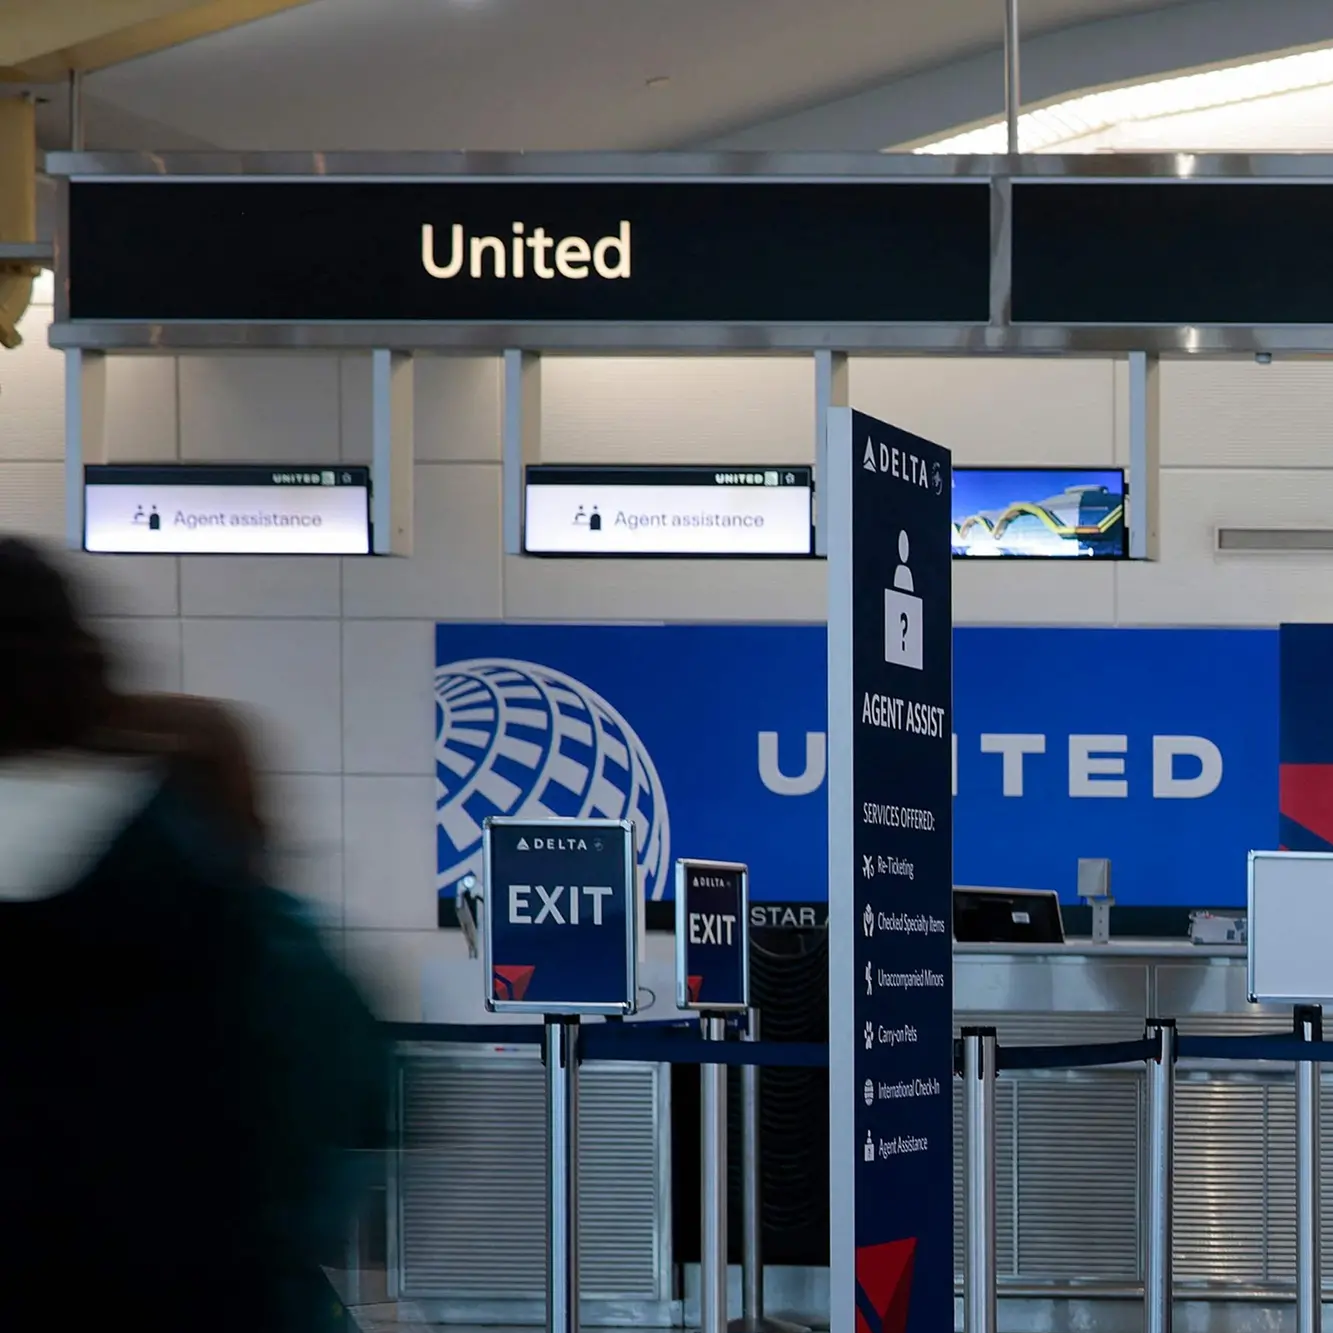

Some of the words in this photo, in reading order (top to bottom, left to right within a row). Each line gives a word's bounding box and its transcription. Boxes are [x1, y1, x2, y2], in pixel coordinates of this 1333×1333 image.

[421, 219, 631, 279] United
[879, 442, 929, 489] DELTA
[272, 474, 320, 484] UNITED
[715, 473, 763, 485] UNITED
[173, 510, 225, 529] Agent
[230, 511, 322, 528] assistance
[614, 510, 667, 529] Agent
[671, 511, 764, 528] assistance
[862, 691, 904, 730] AGENT
[906, 701, 945, 738] ASSIST
[758, 731, 1223, 799] UTED
[863, 802, 899, 827] SERVICES
[900, 807, 935, 831] OFFERED:
[534, 838, 587, 851] DELTA
[877, 855, 914, 880] Re-Ticketing
[700, 877, 725, 888] DELTA
[508, 884, 613, 925] EXIT
[750, 906, 816, 927] STAR
[877, 911, 903, 930] Checked
[904, 913, 929, 936] Specialty
[929, 915, 945, 933] Items
[689, 912, 736, 946] EXIT
[877, 968, 923, 990] Unaccompanied
[924, 969, 944, 987] Minors
[878, 1025, 904, 1047] Carry-on
[905, 1025, 917, 1042] Pets
[878, 1081, 914, 1099] International
[915, 1078, 940, 1097] Check-In
[879, 1138, 897, 1160] Agent
[897, 1135, 928, 1153] Assistance
